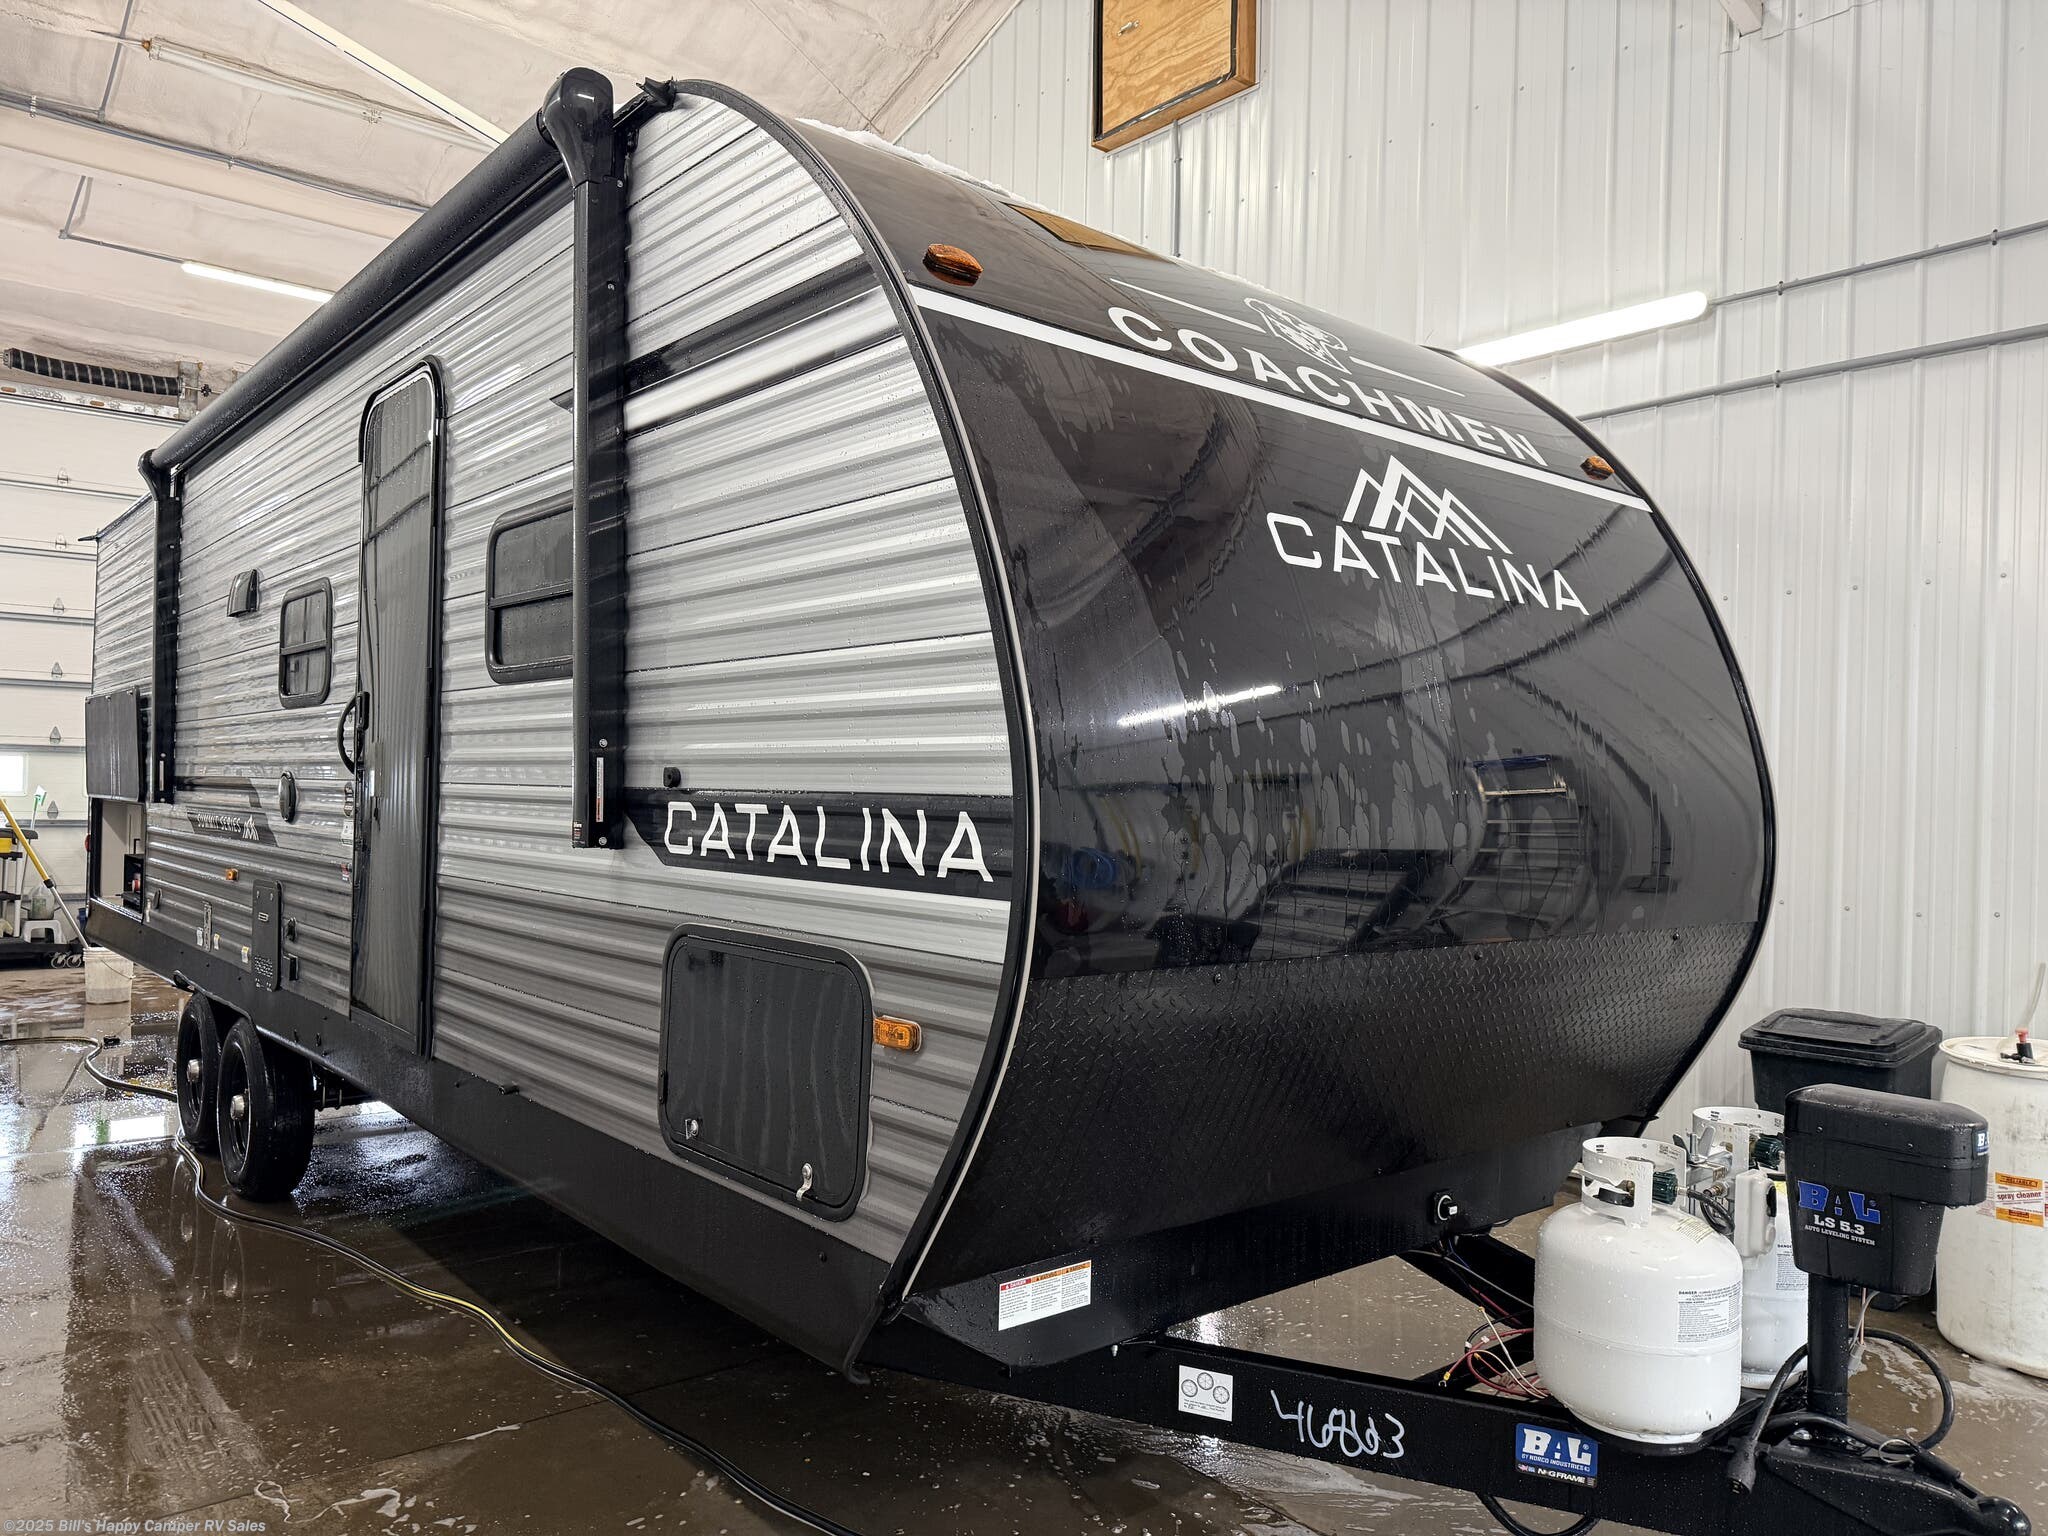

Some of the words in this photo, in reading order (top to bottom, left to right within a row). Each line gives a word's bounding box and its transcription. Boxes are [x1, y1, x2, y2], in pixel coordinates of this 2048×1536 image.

[1107, 306, 1548, 466] COACHMEN
[1266, 512, 1590, 616] CATALINA
[197, 813, 219, 829] SUMMIT
[219, 815, 241, 833] SERIES
[664, 801, 994, 882] CATALINA
[1797, 1180, 1881, 1224] BAL
[1997, 1193, 2014, 1201] spray
[1804, 1224, 1820, 1233] AUTO
[1821, 1228, 1850, 1240] LEVELING
[1850, 1235, 1875, 1246] SYSTEM
[1813, 1214, 1836, 1229] LS
[1840, 1220, 1865, 1236] 5.3
[1270, 1389, 1405, 1458] 46863
[1529, 1455, 1549, 1464] NORCO
[1550, 1459, 1584, 1471] INDUSTRIES
[1556, 1472, 1586, 1484] FRAME
